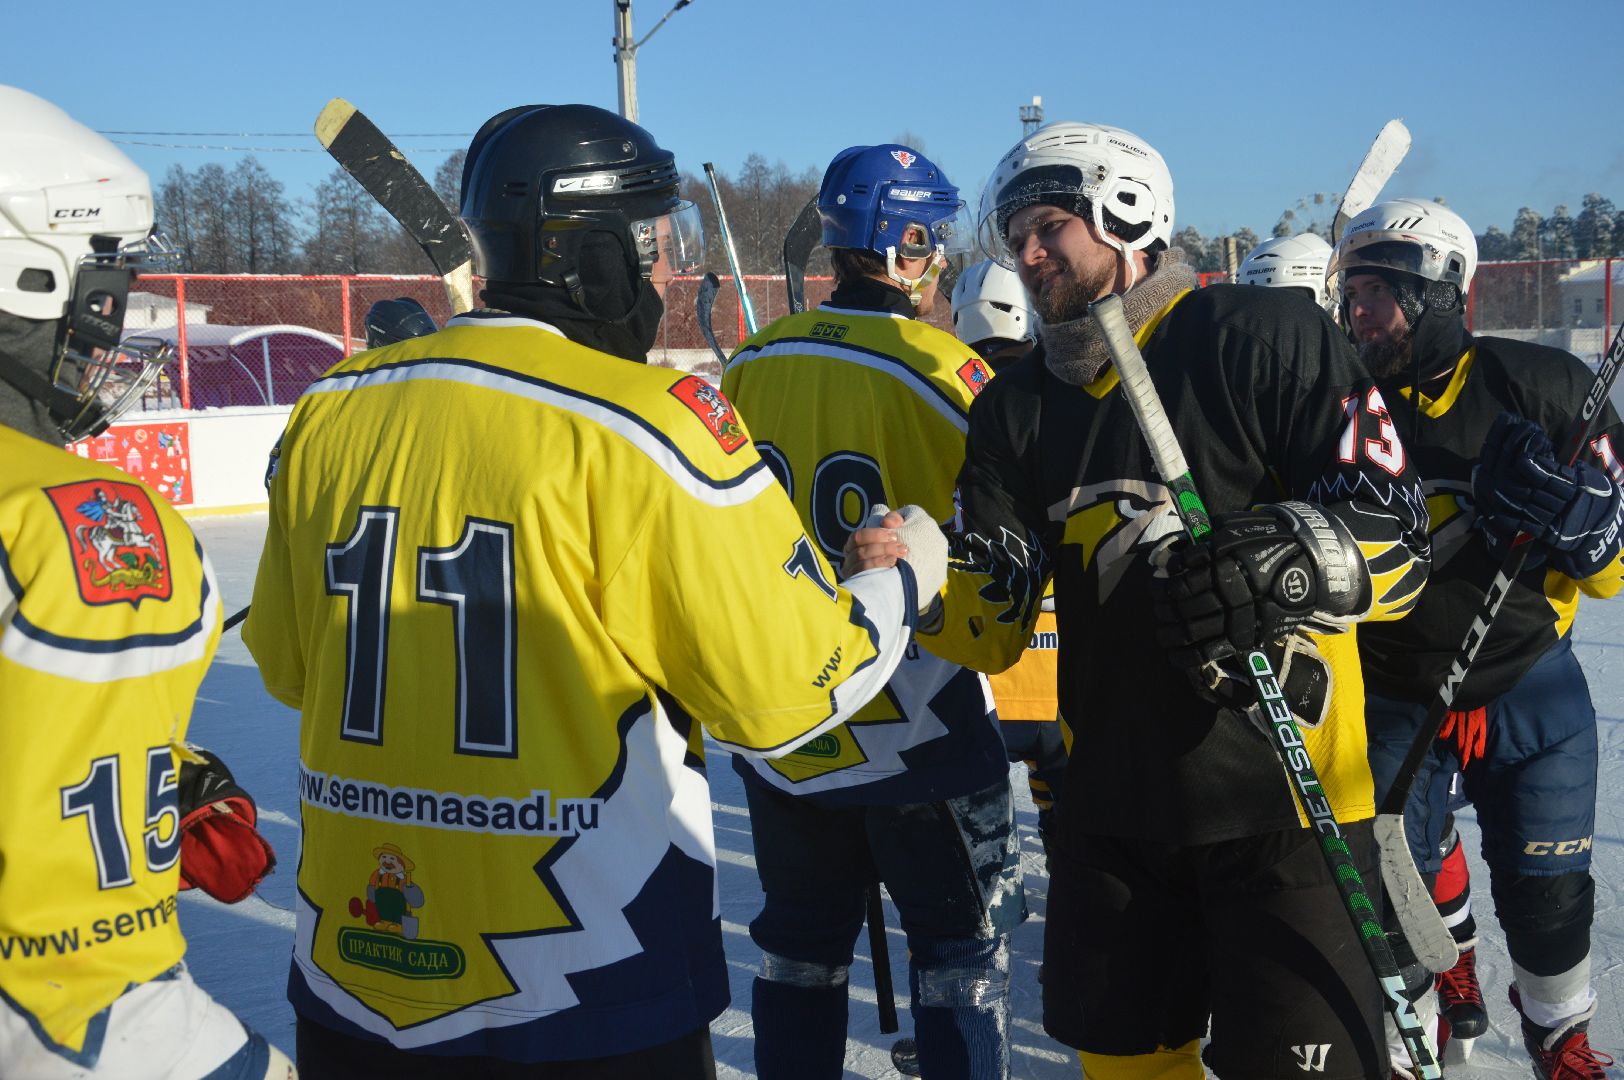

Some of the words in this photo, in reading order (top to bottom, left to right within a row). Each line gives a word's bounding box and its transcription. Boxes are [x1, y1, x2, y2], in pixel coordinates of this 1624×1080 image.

[54, 207, 101, 218] CCM
[890, 188, 932, 199] BAUER
[1246, 267, 1277, 276] BAUER
[1338, 386, 1406, 477] 13
[1588, 485, 1624, 563] UER
[324, 505, 518, 759] 11
[1439, 569, 1513, 707] CCM
[1249, 651, 1341, 839] JETSPEED
[60, 744, 181, 891] 15
[1523, 835, 1592, 856] CCM
[349, 939, 402, 962] ПРАКТИК
[408, 951, 448, 970] САДА
